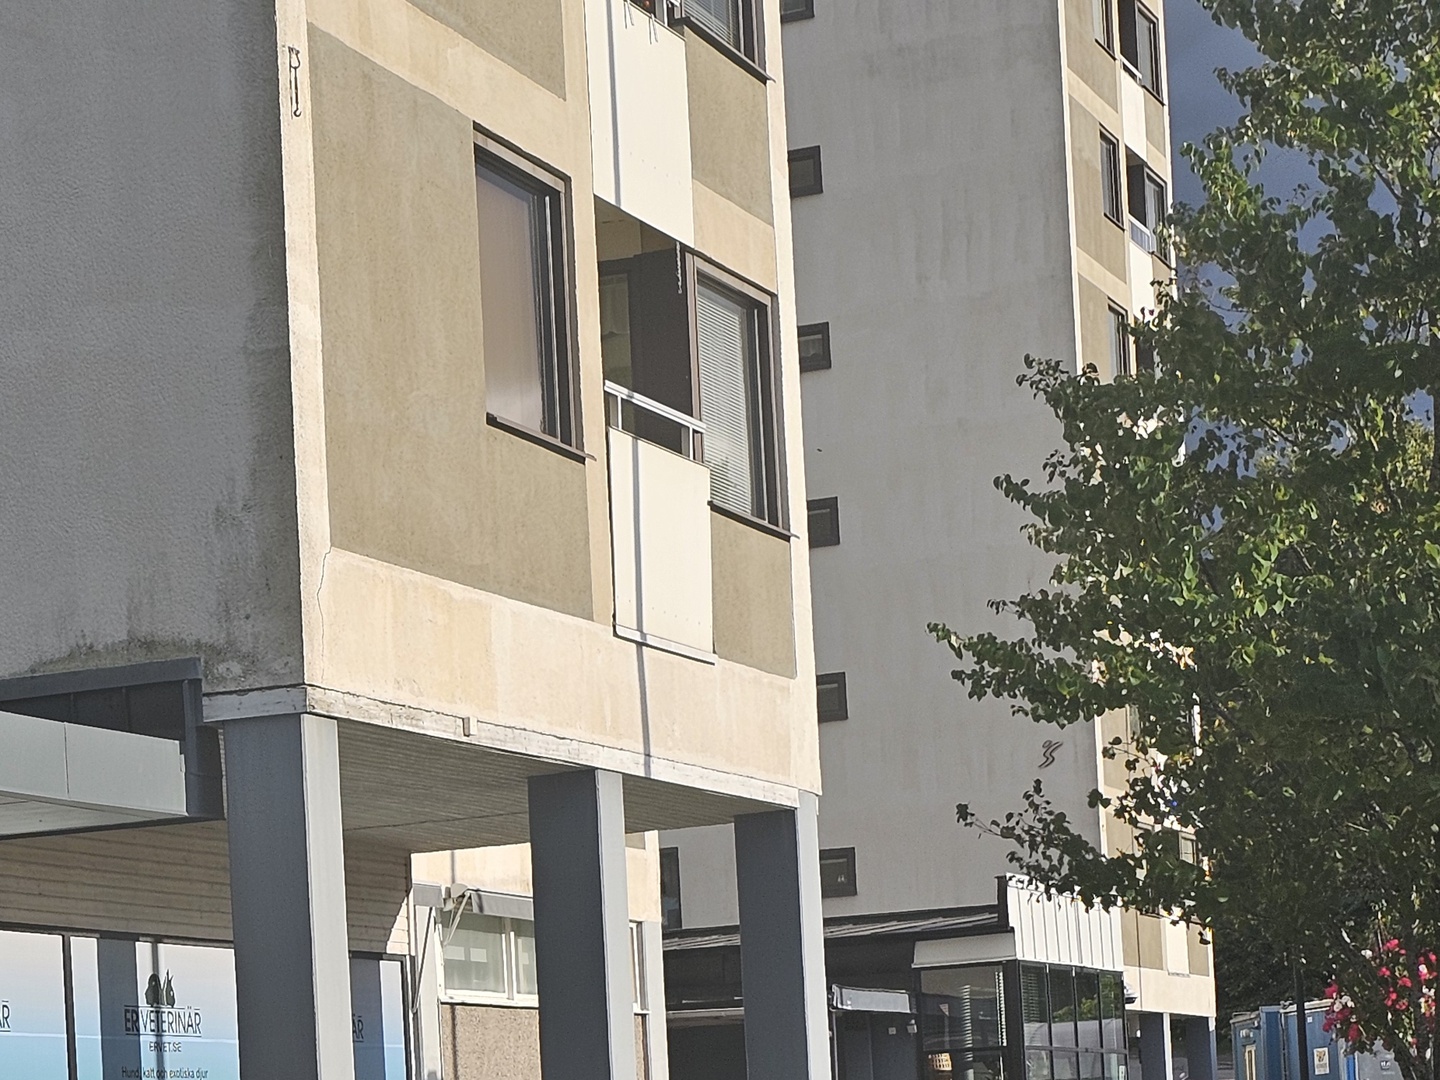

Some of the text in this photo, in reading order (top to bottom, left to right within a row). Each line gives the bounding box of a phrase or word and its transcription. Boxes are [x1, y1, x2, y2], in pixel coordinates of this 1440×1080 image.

[124, 1006, 202, 1034] ER VETERINÄR
[149, 1041, 182, 1053] ERVET.SE
[195, 1067, 209, 1080] djur
